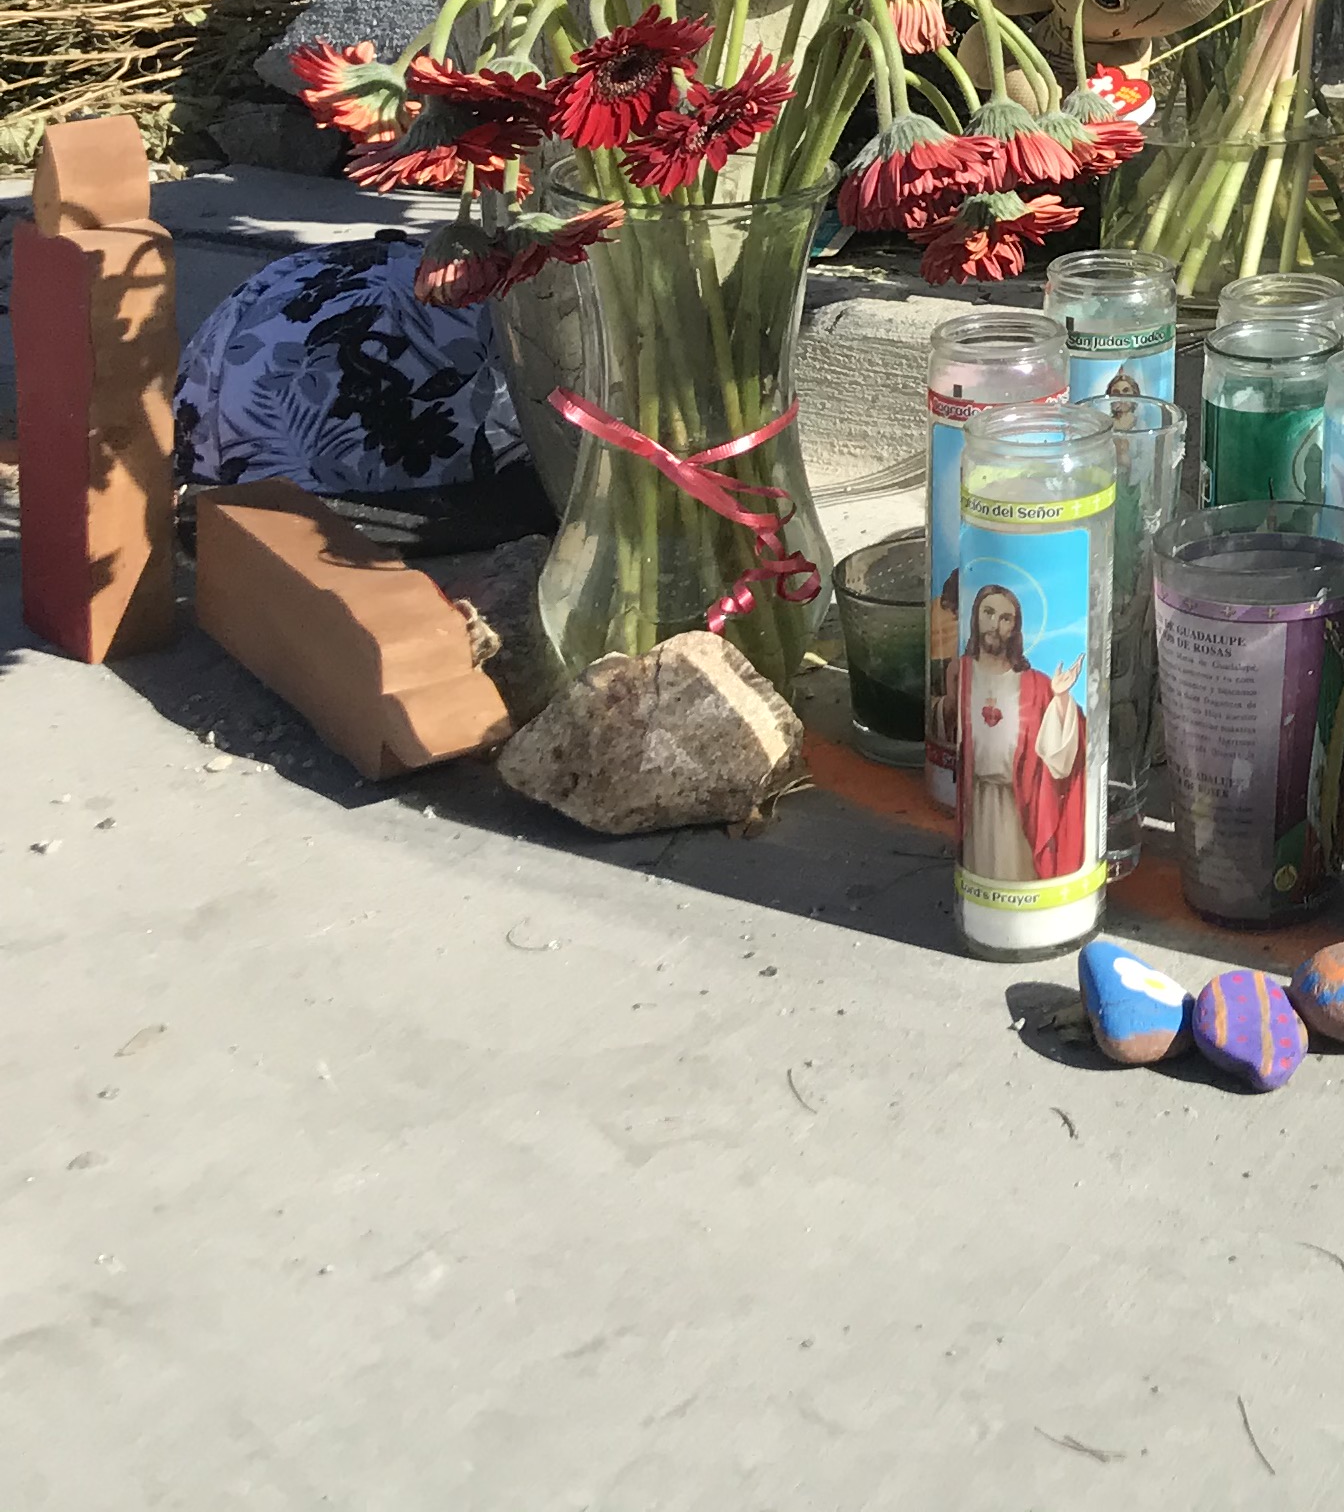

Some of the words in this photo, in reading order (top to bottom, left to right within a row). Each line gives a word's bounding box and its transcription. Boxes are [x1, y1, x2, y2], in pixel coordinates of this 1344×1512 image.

[1069, 334, 1091, 347] San
[1092, 335, 1131, 349] Judas
[1132, 331, 1165, 345] Tadeo
[992, 505, 1013, 518] del
[1017, 505, 1064, 519] Señor
[1176, 624, 1247, 648] GUADALUPE
[1193, 642, 1233, 658] ROSAS
[992, 890, 1040, 907] Prayer
